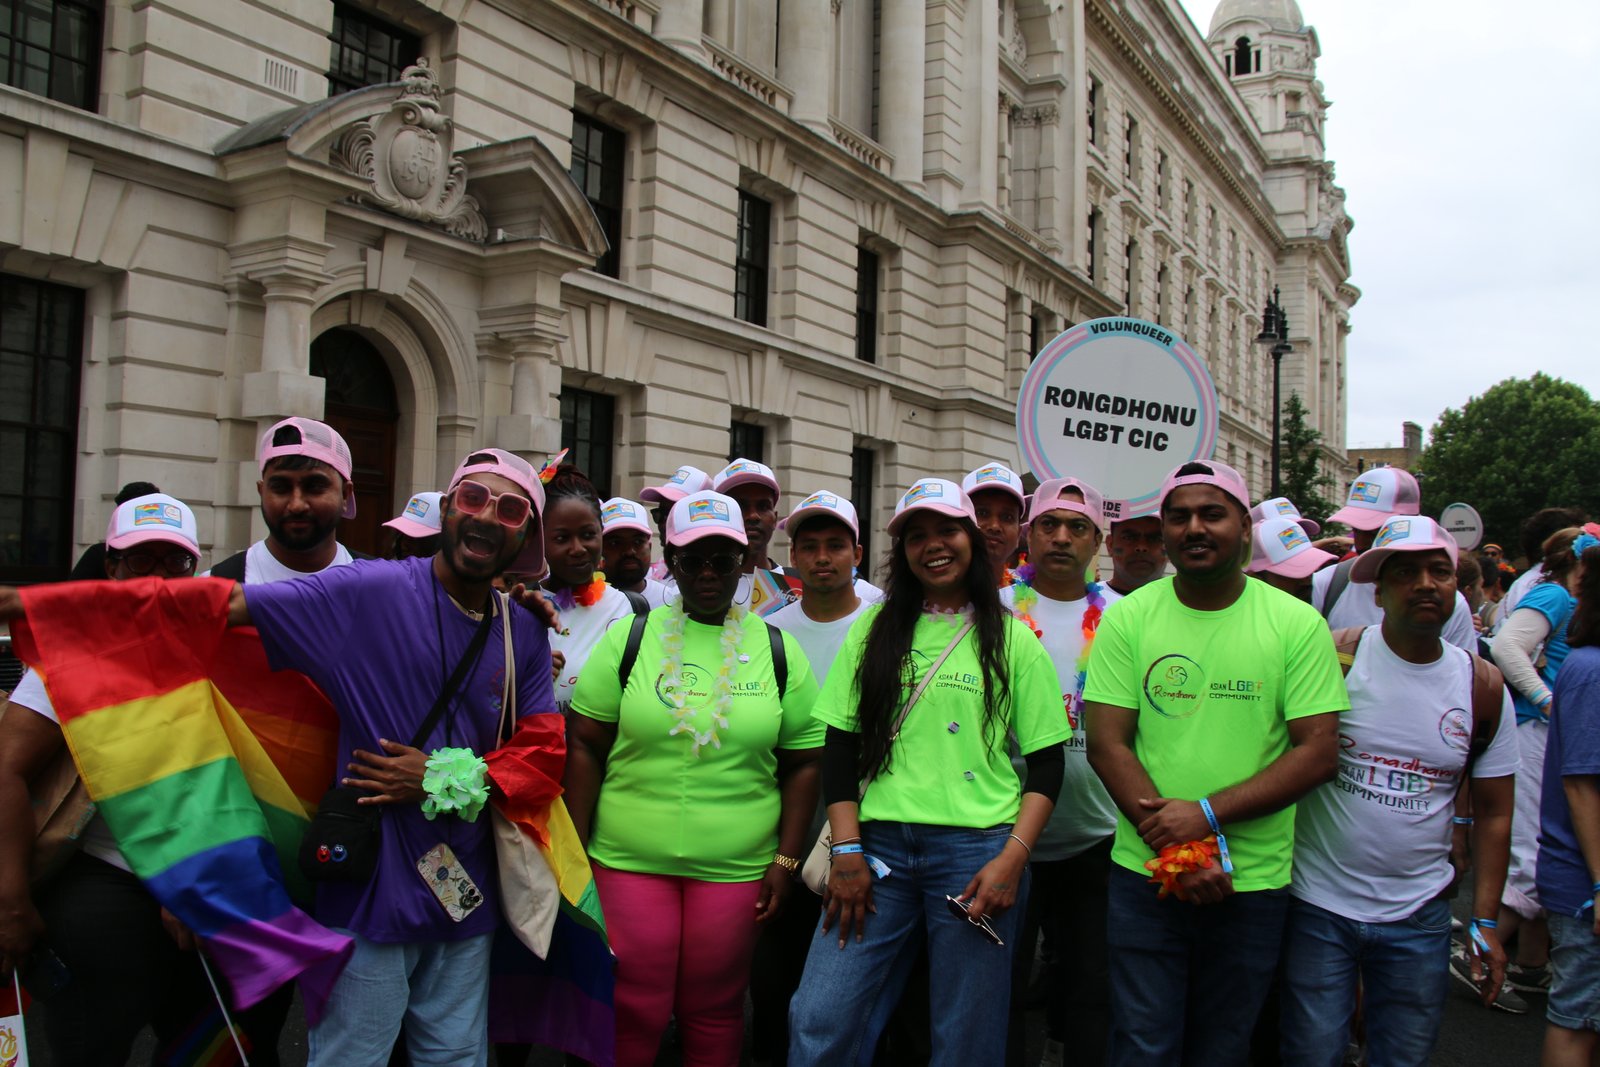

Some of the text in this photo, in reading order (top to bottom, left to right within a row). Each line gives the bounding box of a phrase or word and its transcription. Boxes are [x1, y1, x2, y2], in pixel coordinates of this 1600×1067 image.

[1090, 320, 1173, 347] VOLUNQUEER
[1044, 385, 1197, 427] RONGDHONU
[1062, 417, 1169, 452] LGBT CIC
[1209, 692, 1262, 702] COMMUNITY
[1210, 679, 1264, 693] ASIAN LGBT
